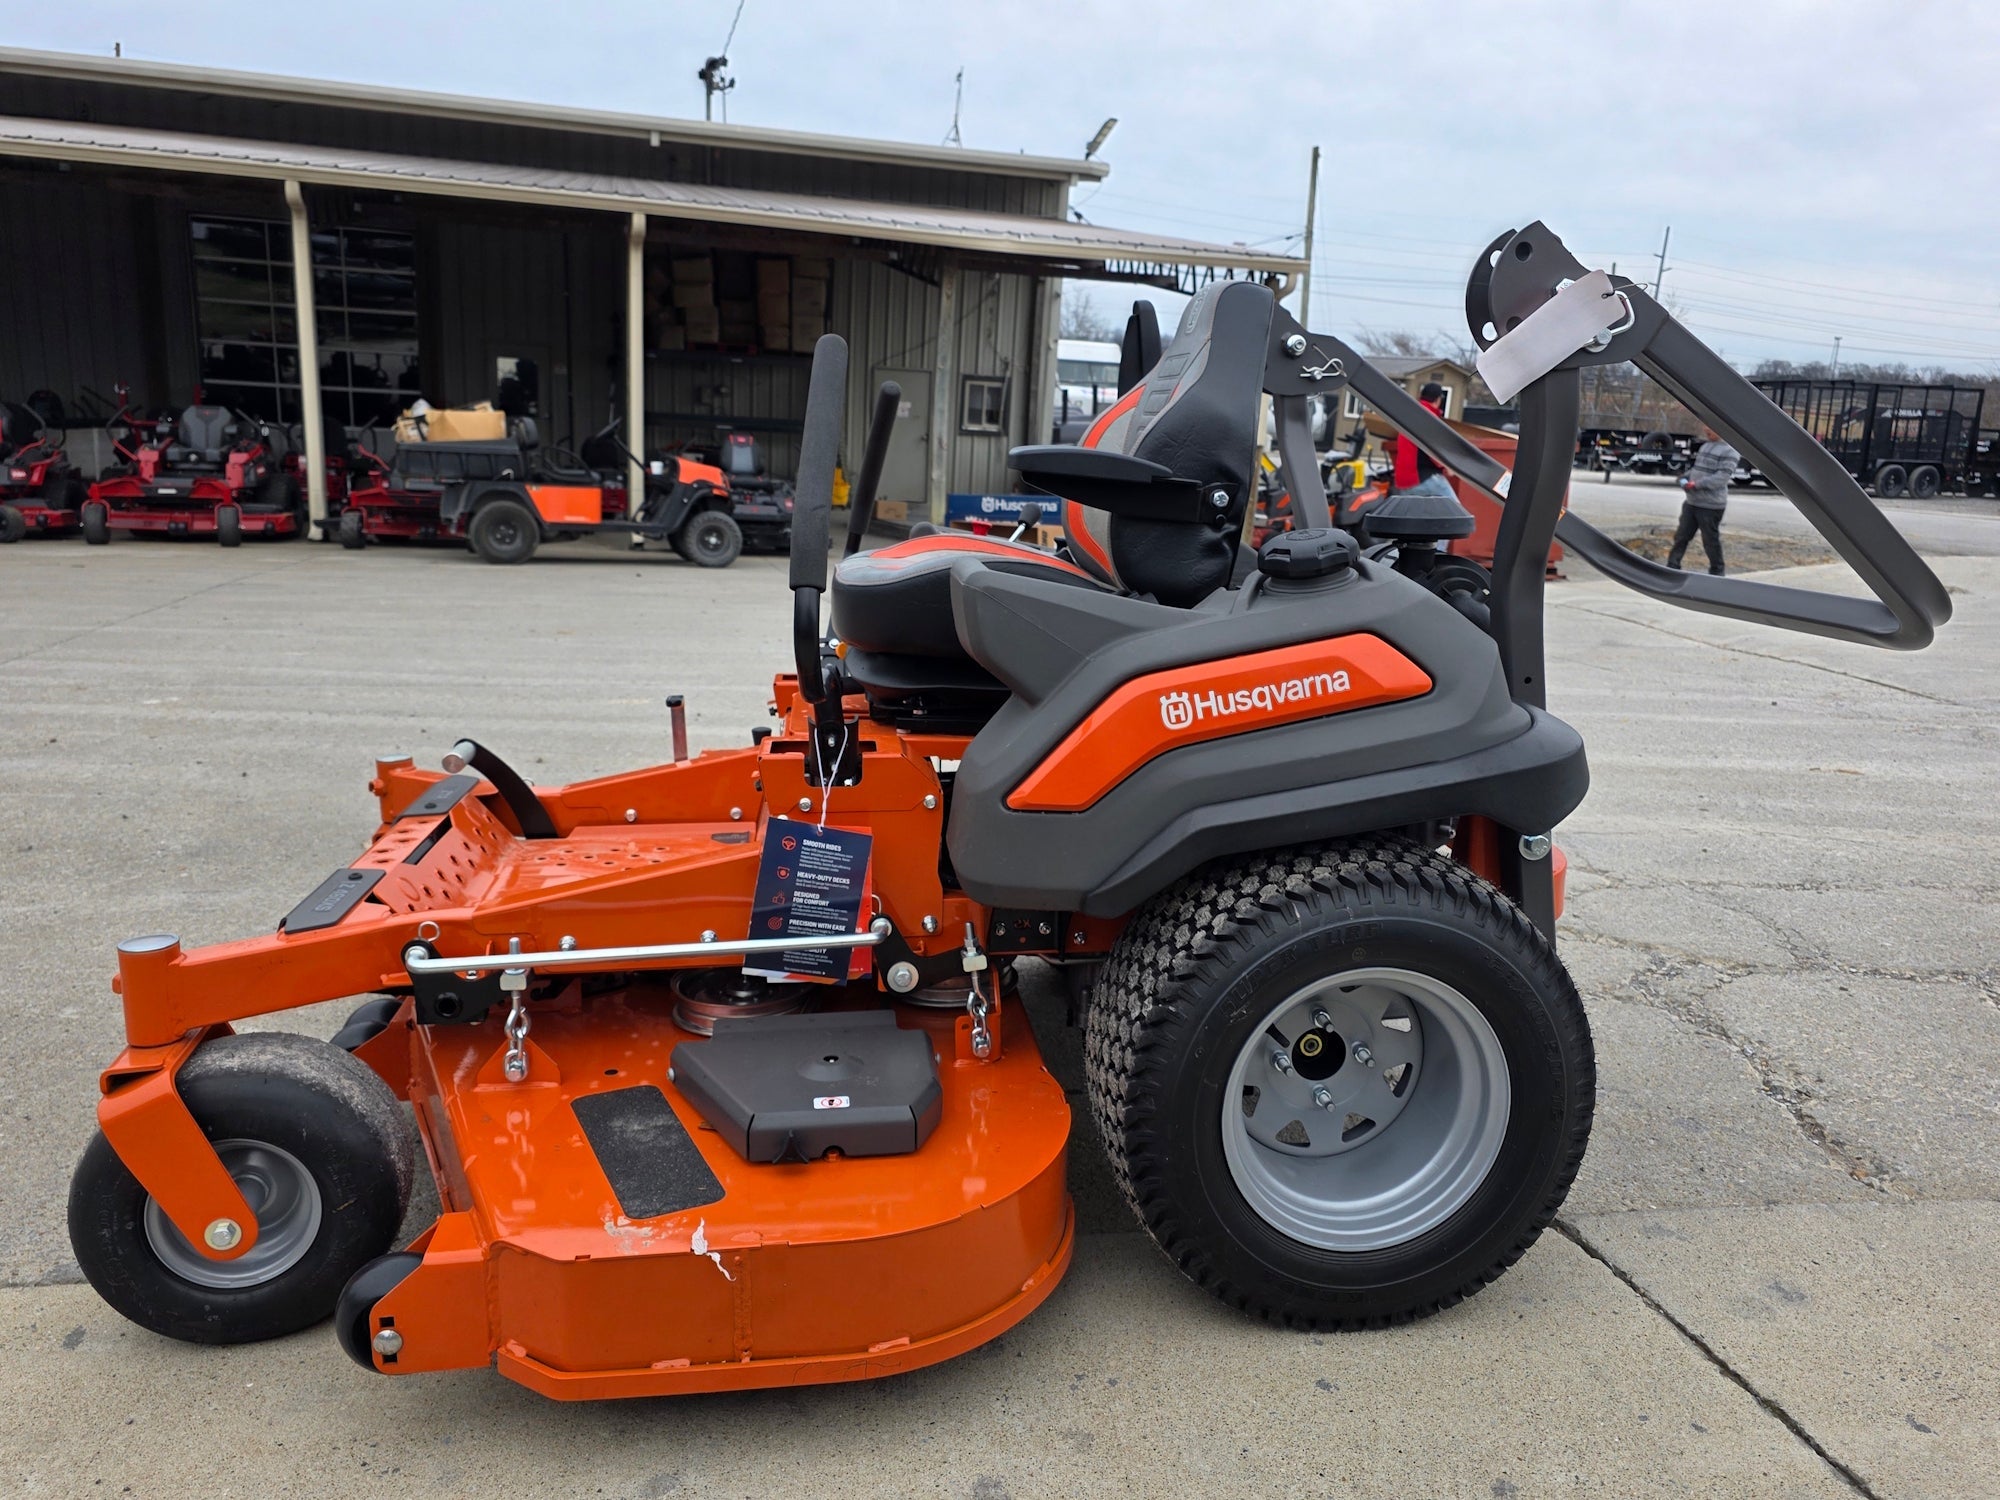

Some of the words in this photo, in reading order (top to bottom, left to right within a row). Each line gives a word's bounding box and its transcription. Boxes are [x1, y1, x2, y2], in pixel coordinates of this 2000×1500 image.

[995, 499, 1058, 512] Husqna
[1194, 670, 1351, 719] Husqvarna
[803, 839, 825, 849] SMOOTH
[826, 844, 842, 852] RIDES
[797, 871, 832, 882] HEAVY-DUTY
[832, 876, 850, 884] DECKS
[793, 890, 820, 899] DESIGNED
[789, 919, 817, 928] PRECISION
[817, 922, 832, 930] WITH
